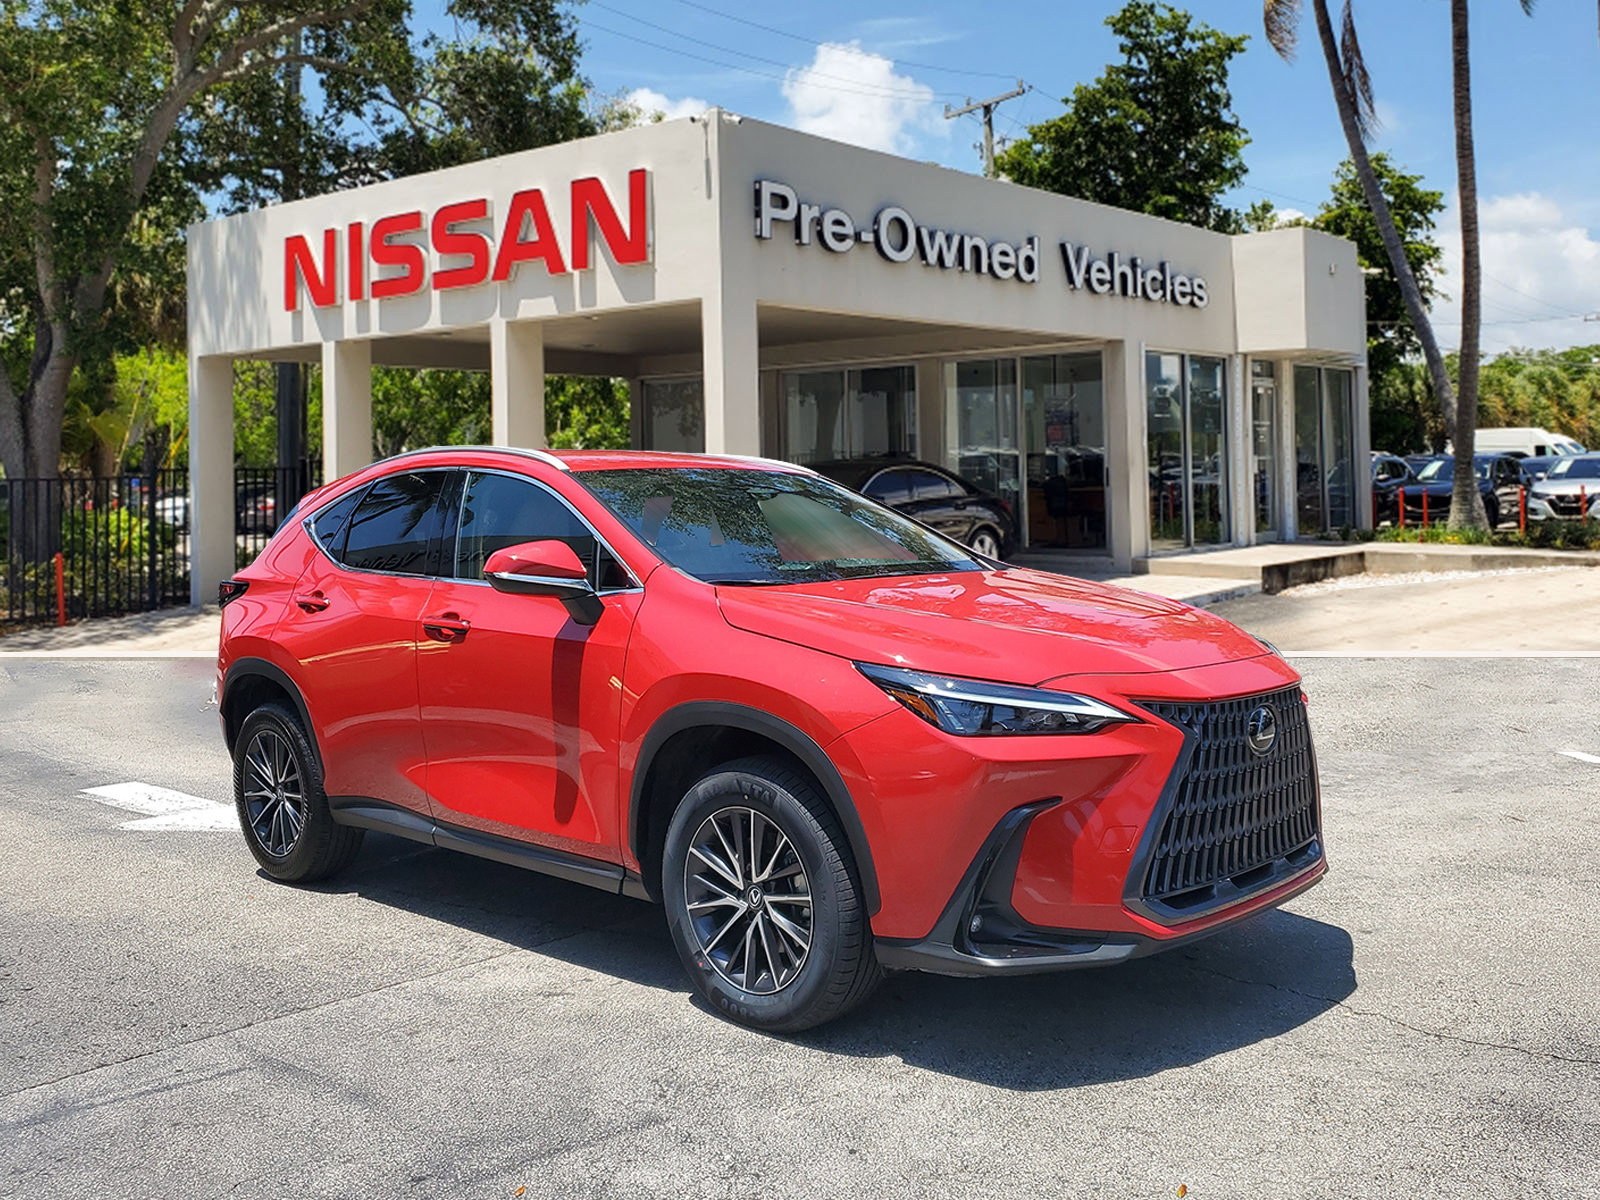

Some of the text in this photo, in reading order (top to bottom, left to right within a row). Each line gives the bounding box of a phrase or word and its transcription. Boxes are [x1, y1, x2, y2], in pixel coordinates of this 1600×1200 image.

[285, 168, 649, 312] NISSAN
[754, 179, 1208, 308] Pre-Owned Vehicles
